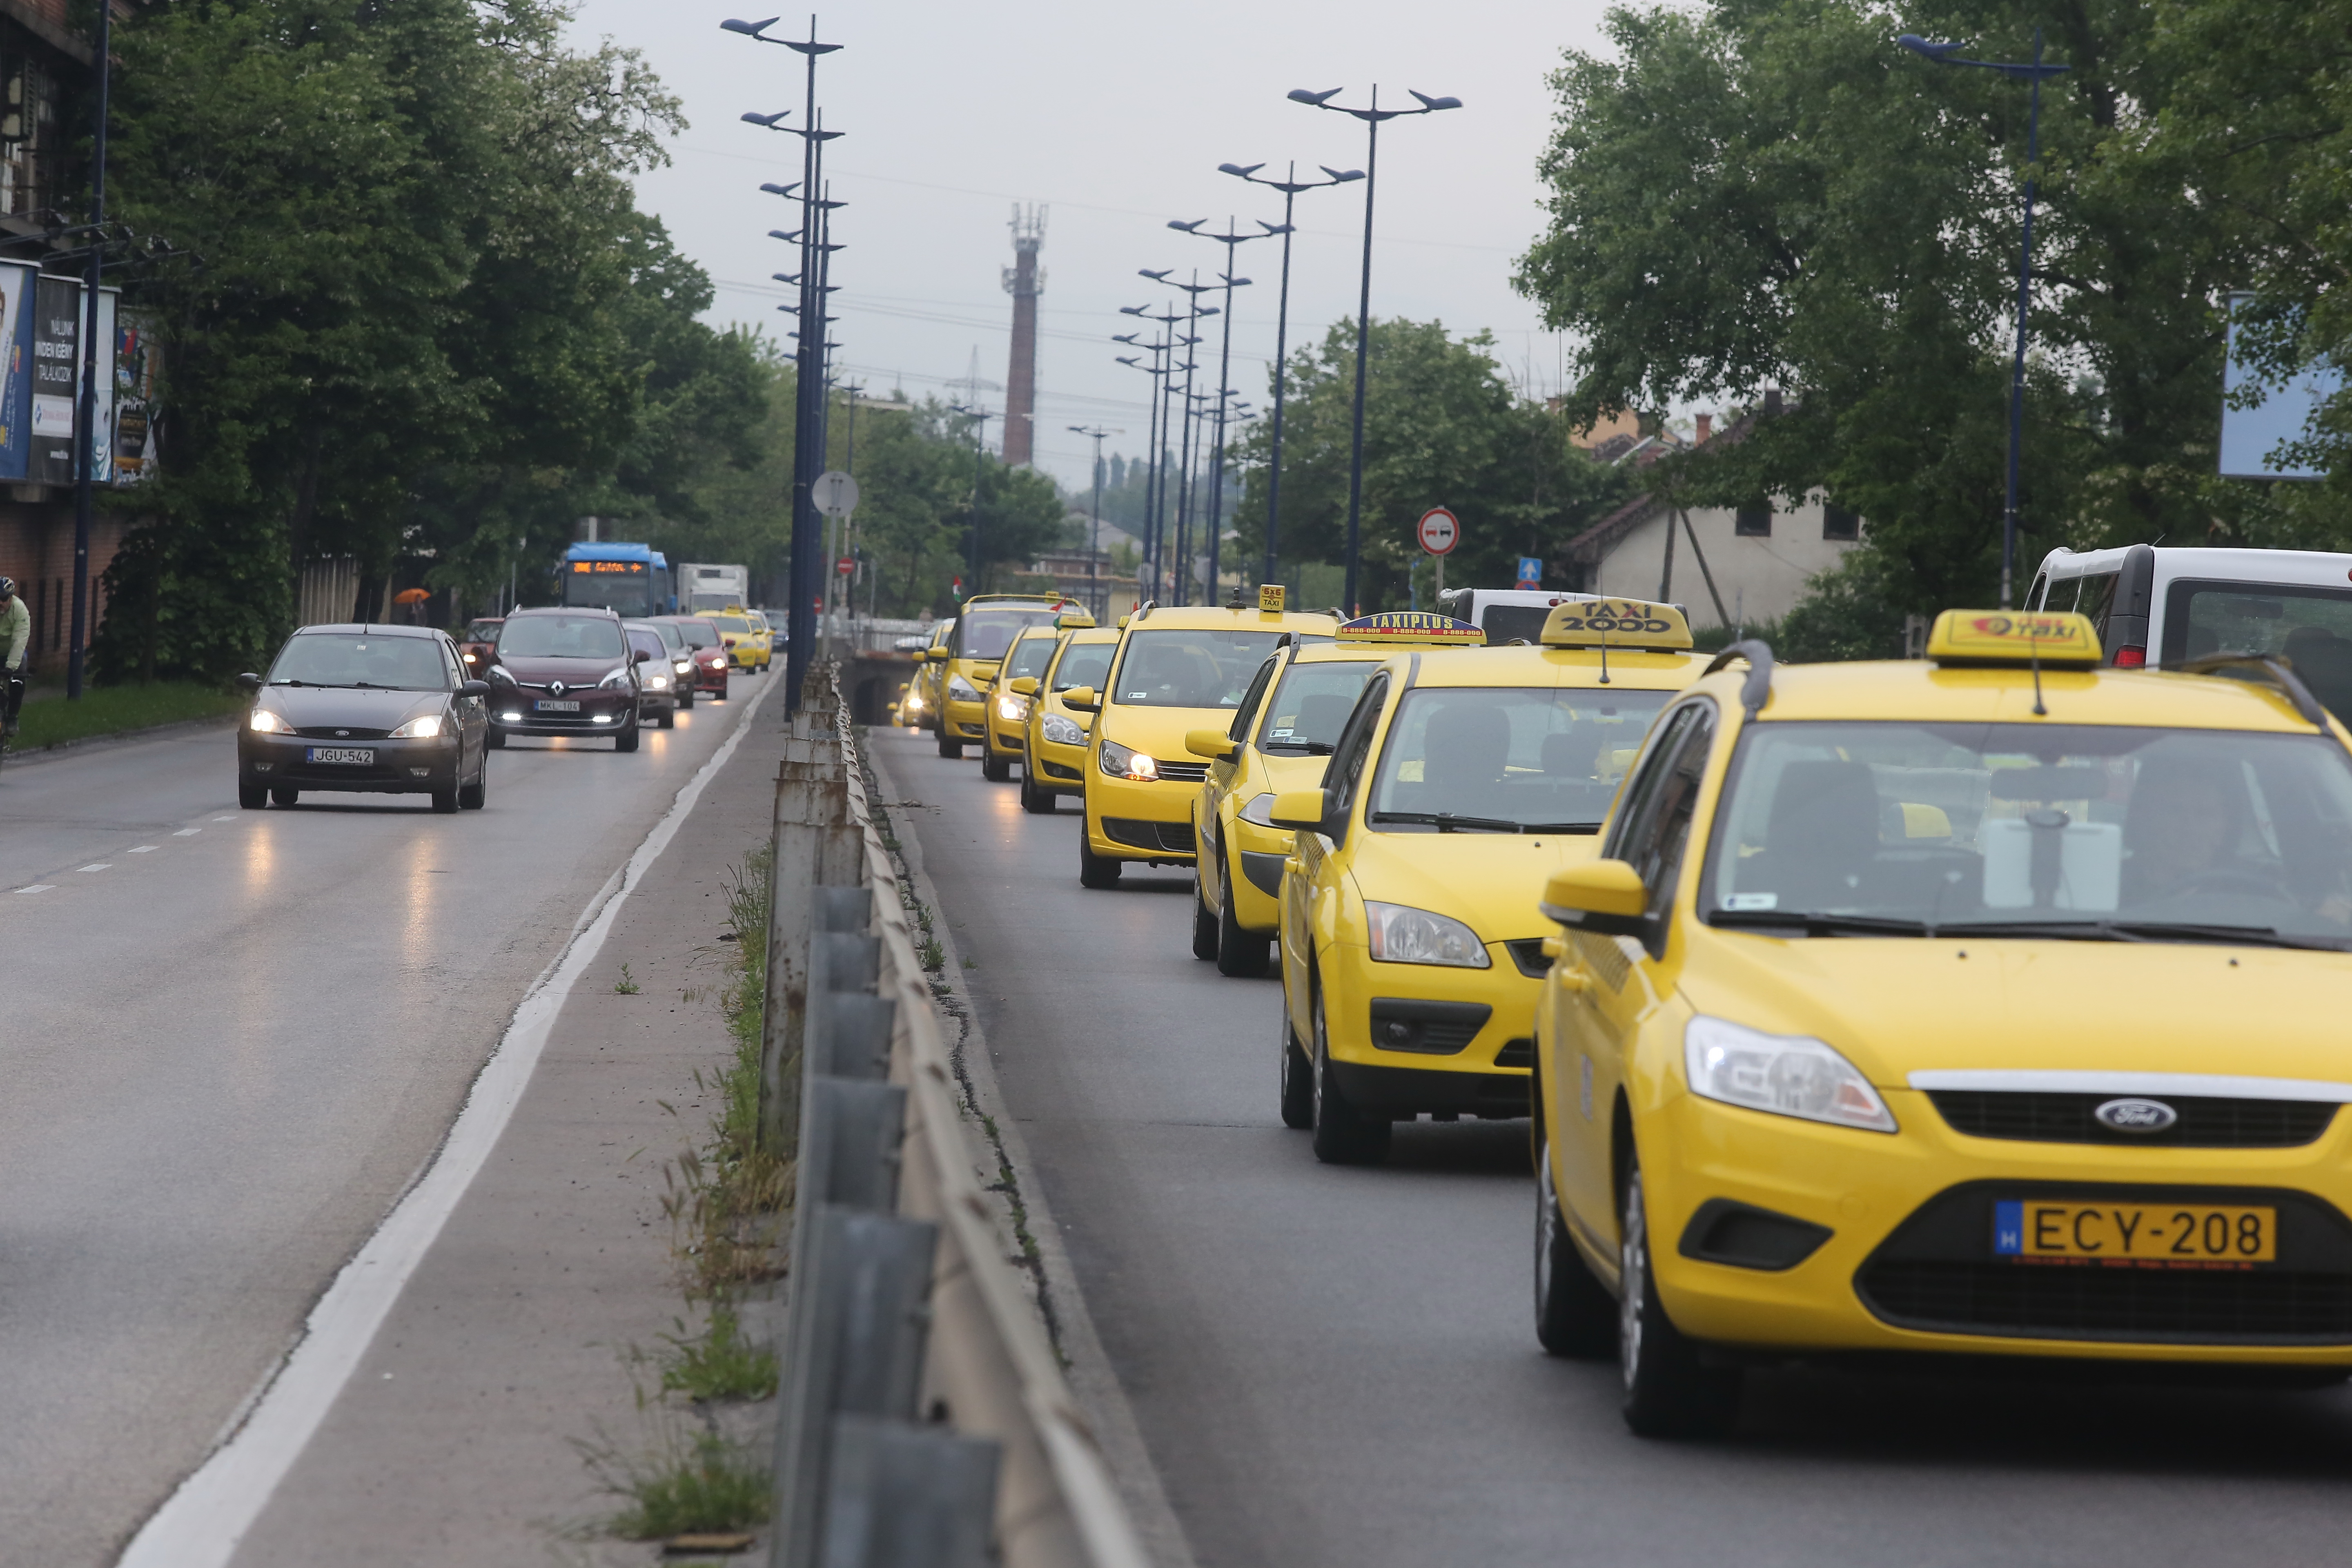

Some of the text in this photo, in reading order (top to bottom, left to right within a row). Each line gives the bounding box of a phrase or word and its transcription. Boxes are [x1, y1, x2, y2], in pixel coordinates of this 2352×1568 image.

[1371, 614, 1453, 629] TAXIPLUS
[1561, 617, 1671, 633] 2000
[540, 702, 577, 710] MKL-104
[316, 750, 370, 763] JGU-542
[2001, 1209, 2261, 1255] H ECY-208
